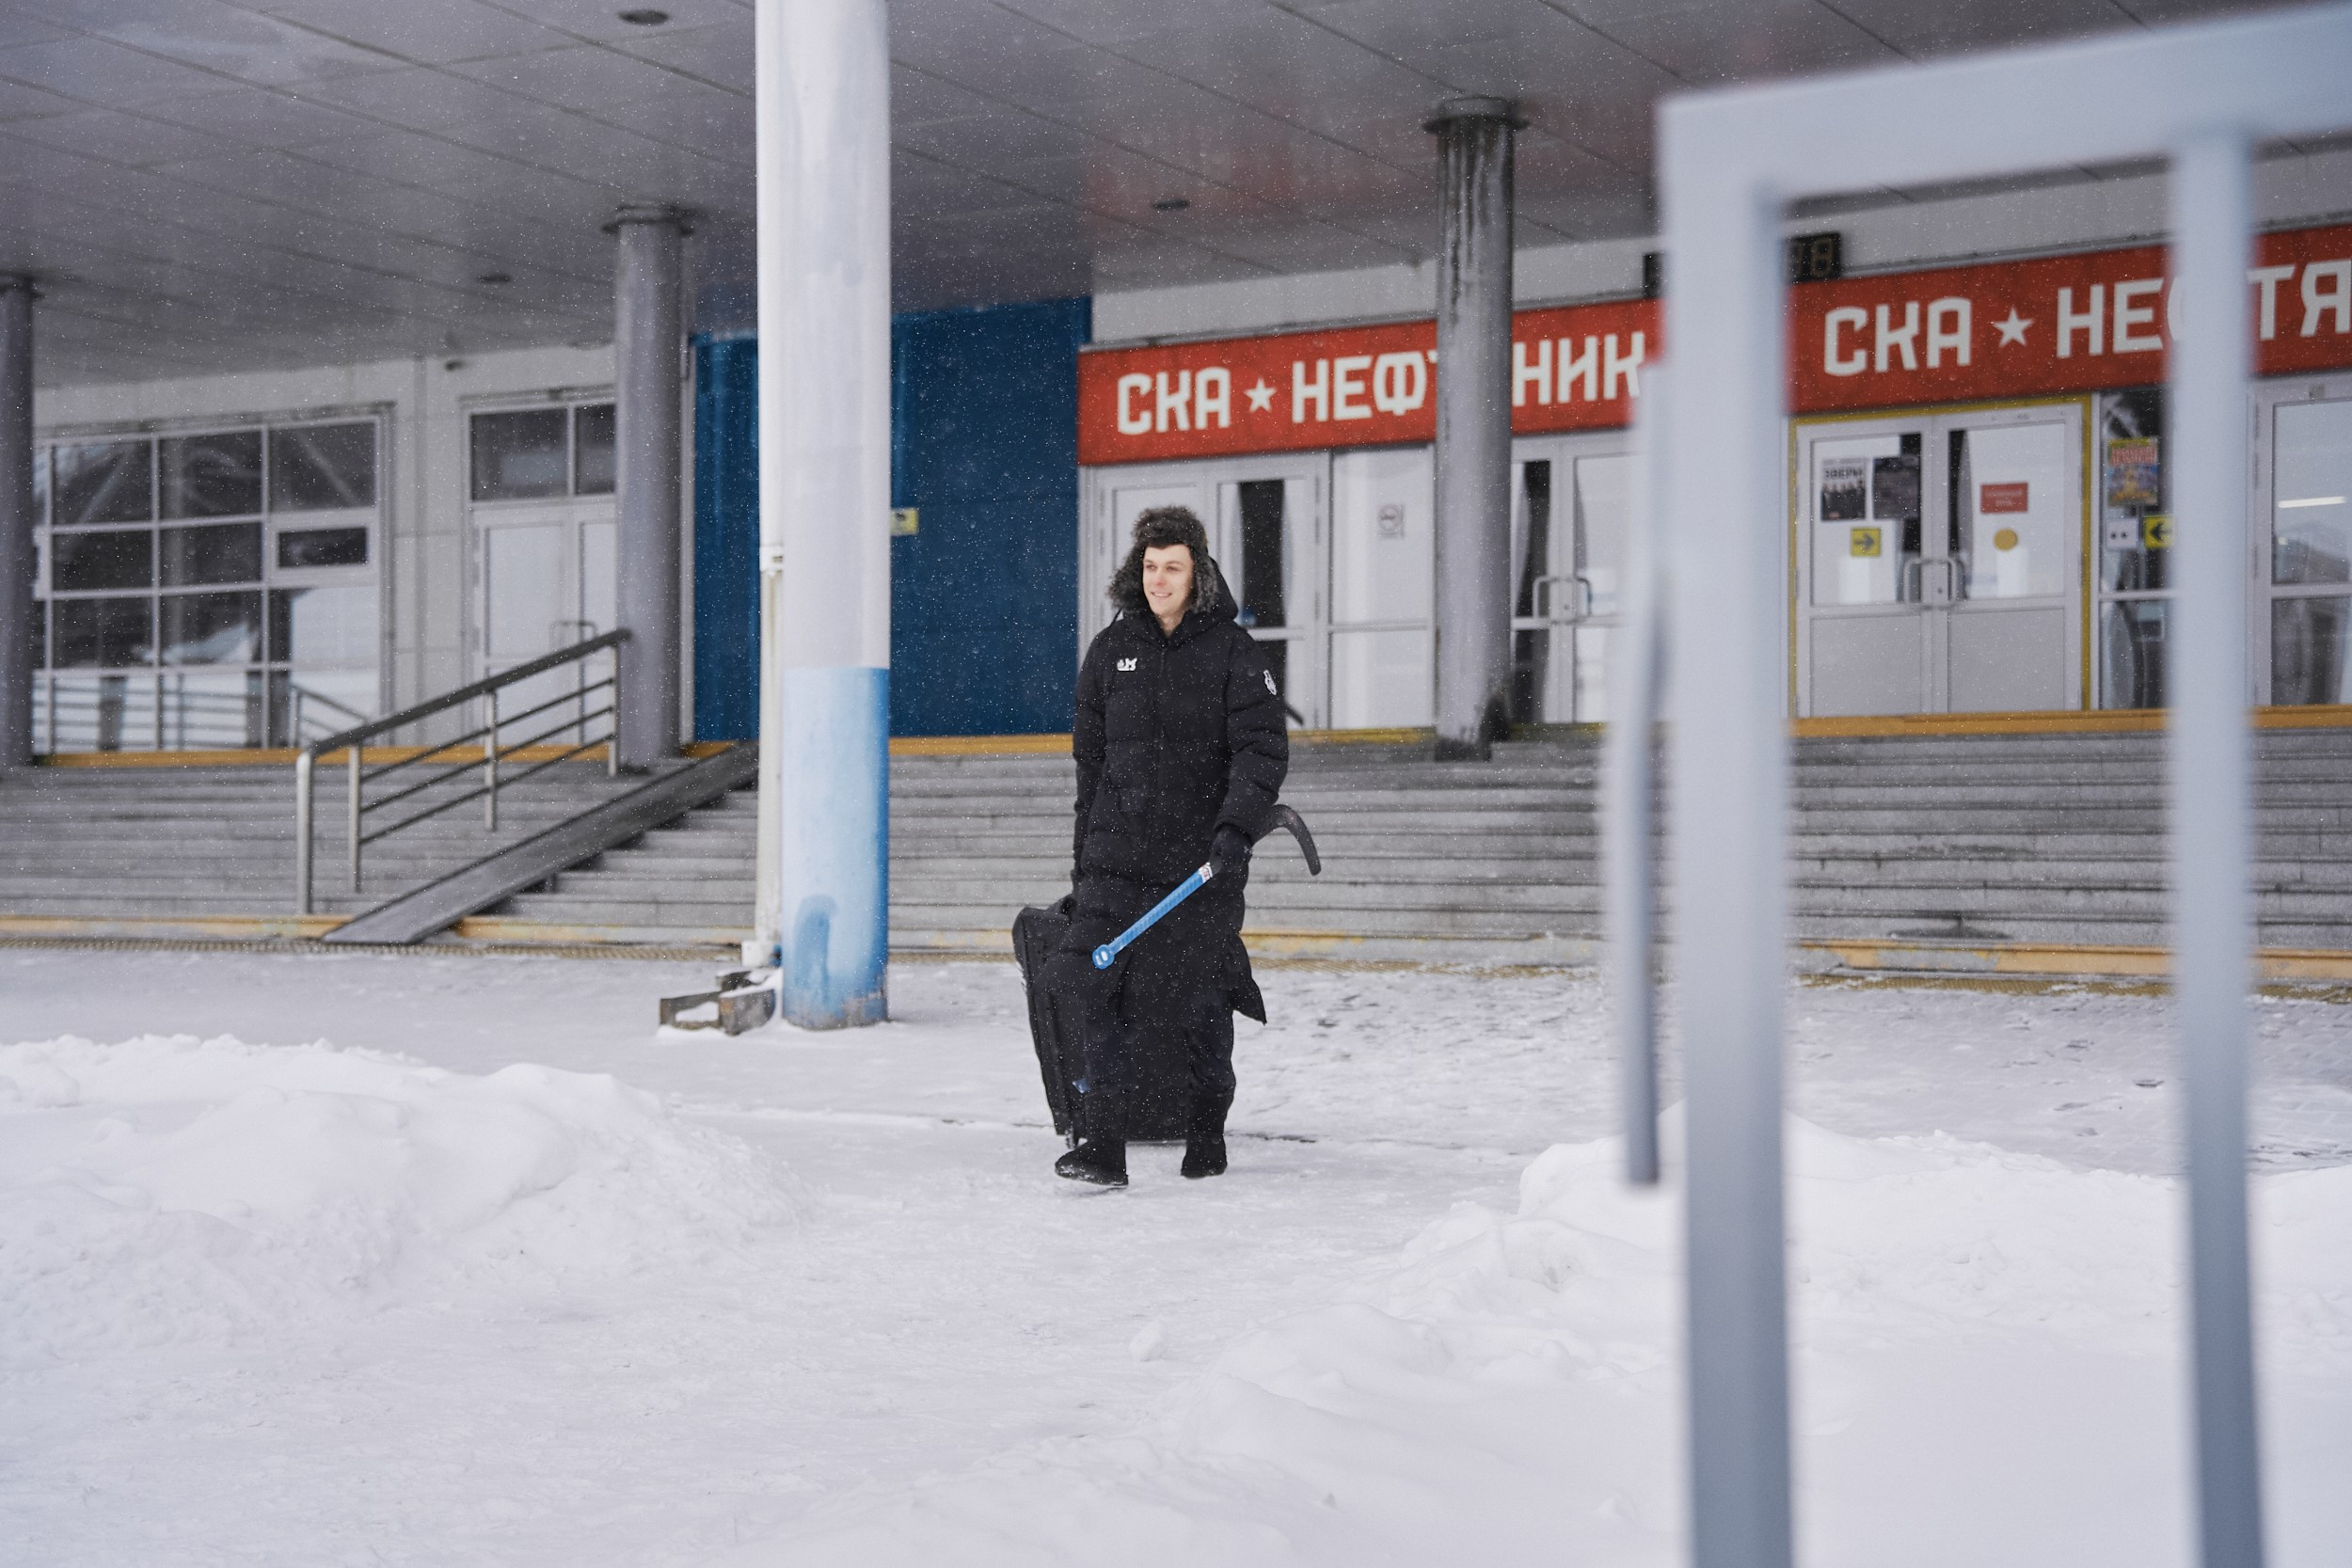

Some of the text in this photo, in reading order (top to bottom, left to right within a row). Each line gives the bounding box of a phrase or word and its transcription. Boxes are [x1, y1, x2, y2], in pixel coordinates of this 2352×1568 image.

[1823, 258, 2352, 377] СКА НЕТЯ
[1117, 332, 1643, 435] СКА НЕФНИК
